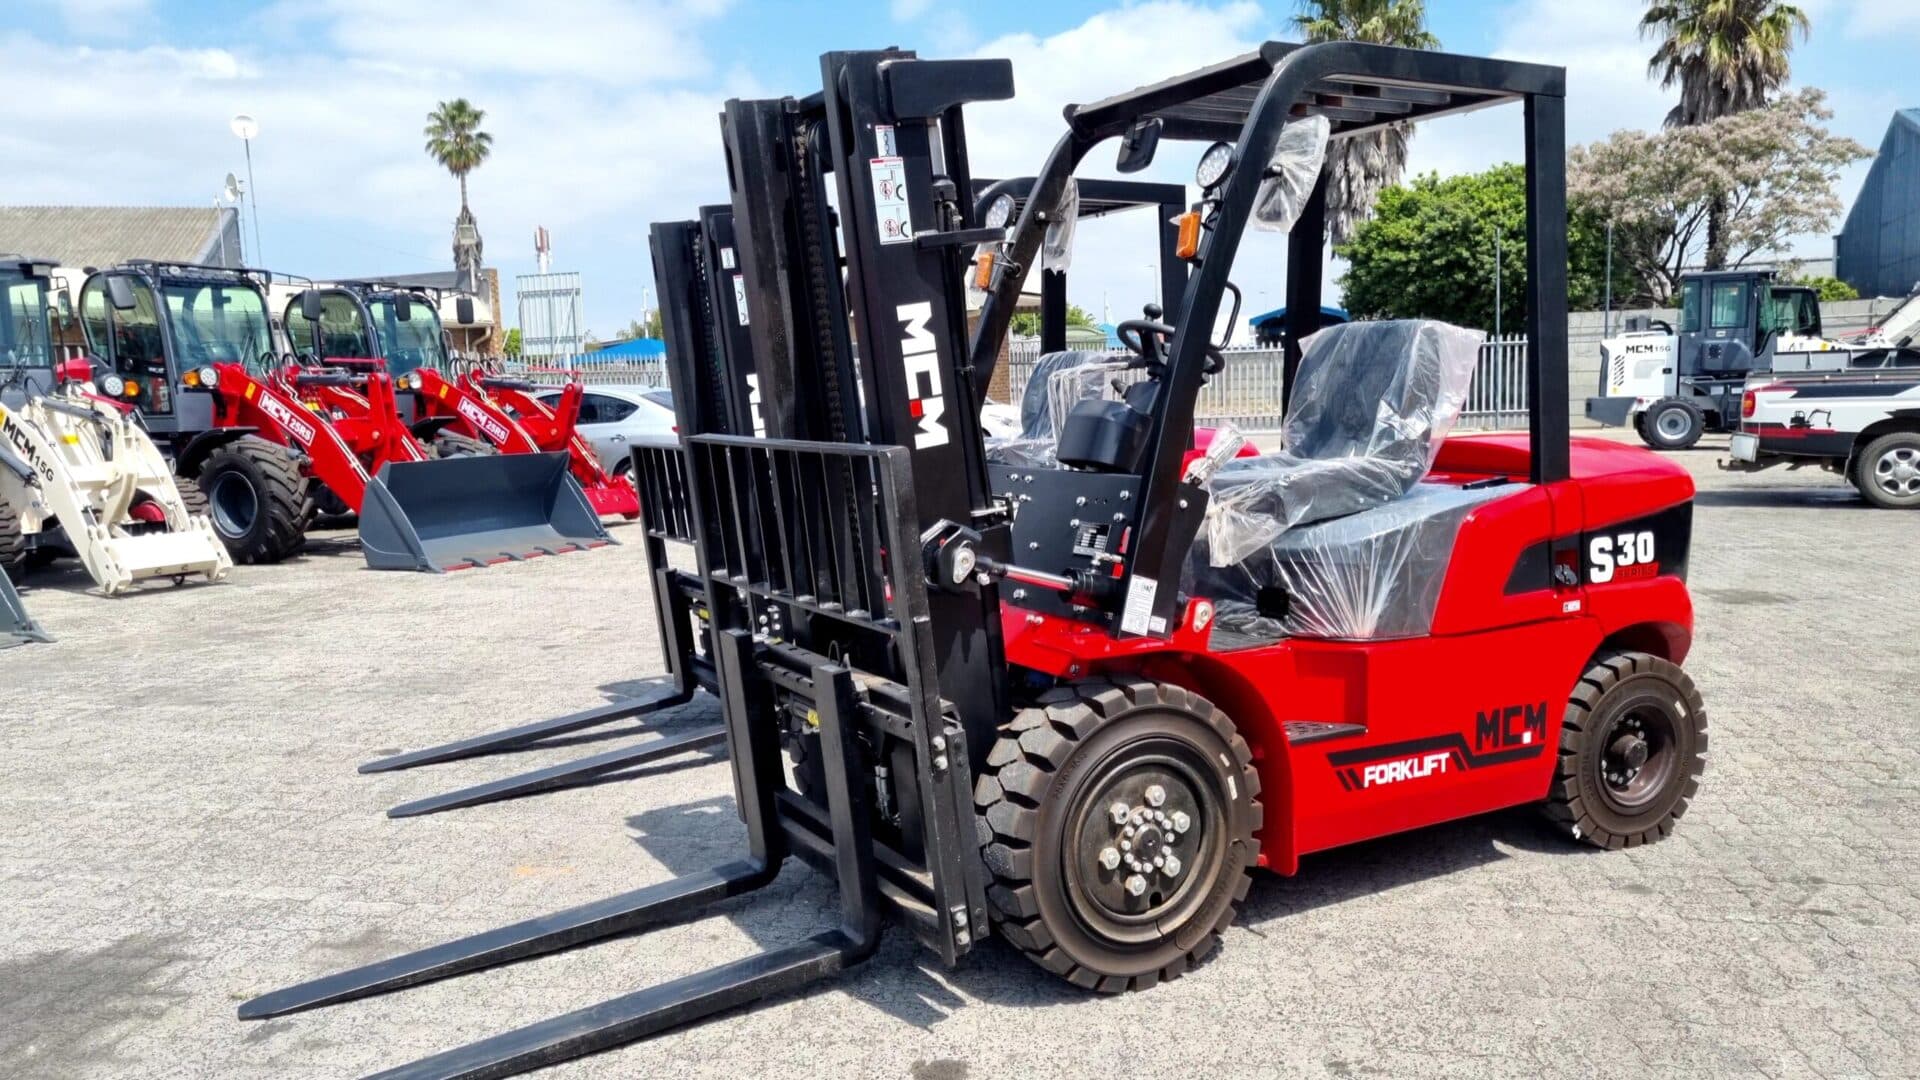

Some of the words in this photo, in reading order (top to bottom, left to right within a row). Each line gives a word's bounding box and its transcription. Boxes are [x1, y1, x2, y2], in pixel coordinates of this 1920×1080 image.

[1626, 344, 1653, 354] MCM
[896, 301, 949, 450] MCM
[261, 395, 290, 425] MCM
[461, 400, 488, 427] MCM
[3, 415, 36, 462] MCM
[35, 456, 54, 482] 15G
[1475, 701, 1548, 752] MCM
[1363, 752, 1450, 788] FORKLIFT
